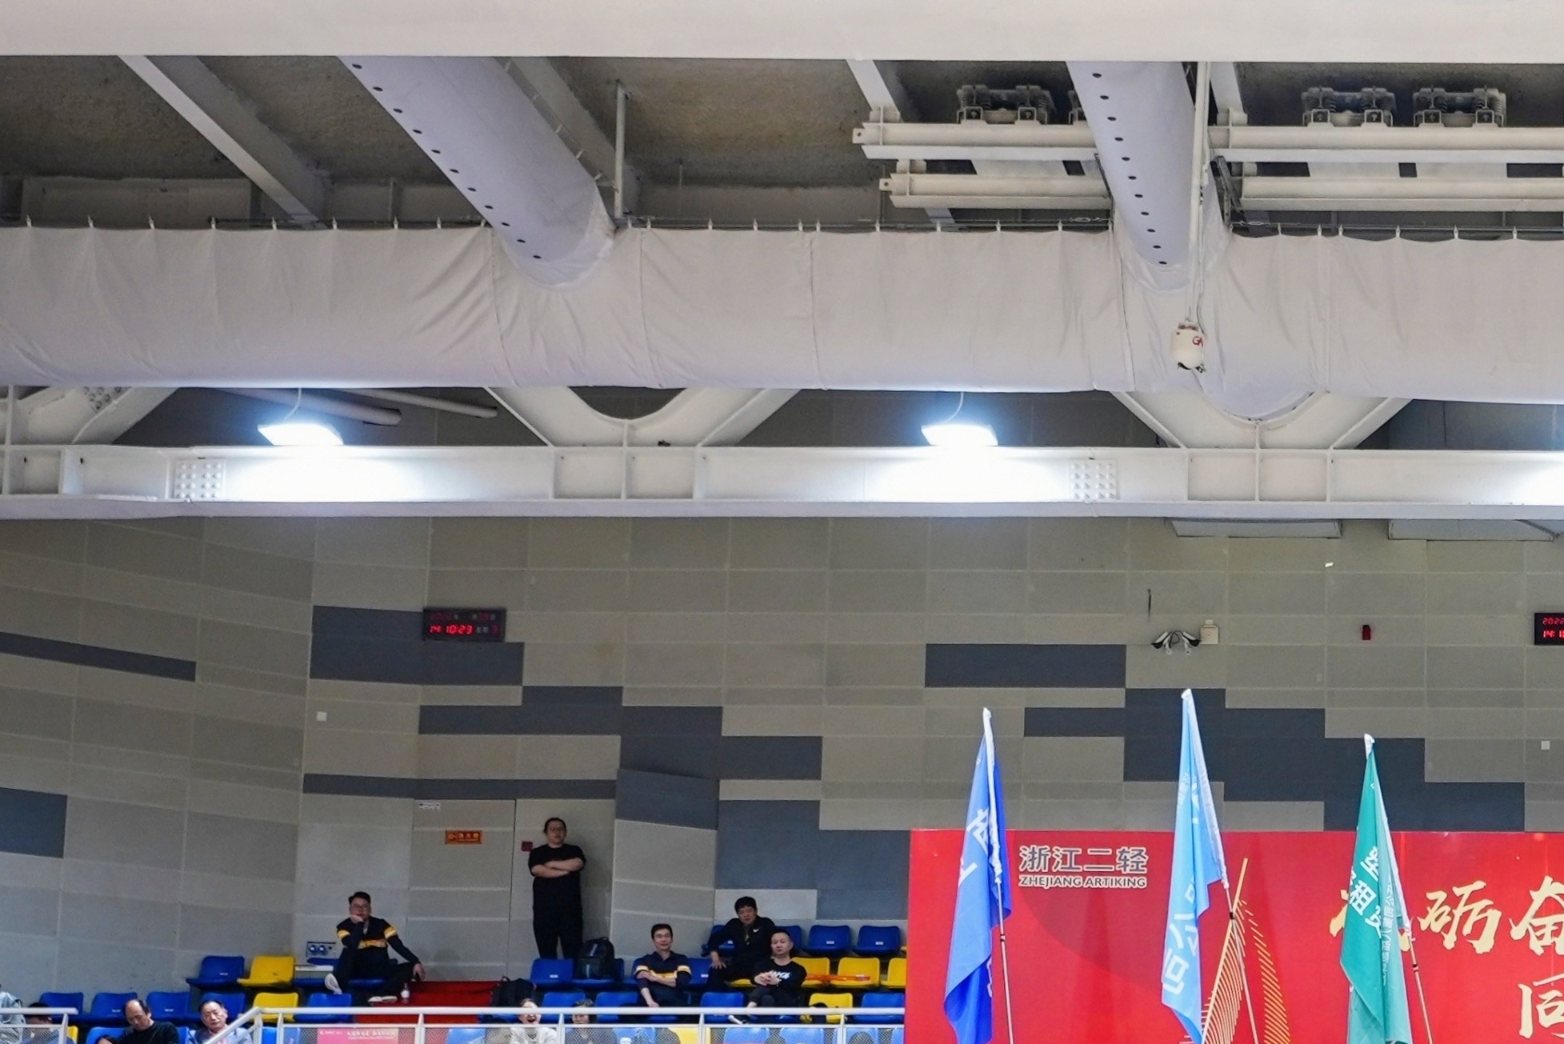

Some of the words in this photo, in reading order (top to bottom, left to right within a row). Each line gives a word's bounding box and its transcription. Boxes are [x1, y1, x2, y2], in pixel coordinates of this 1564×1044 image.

[1019, 845, 1148, 873] 浙江二轻
[1018, 874, 1083, 889] ZHEJIANG
[1084, 875, 1147, 889] ARTIKING
